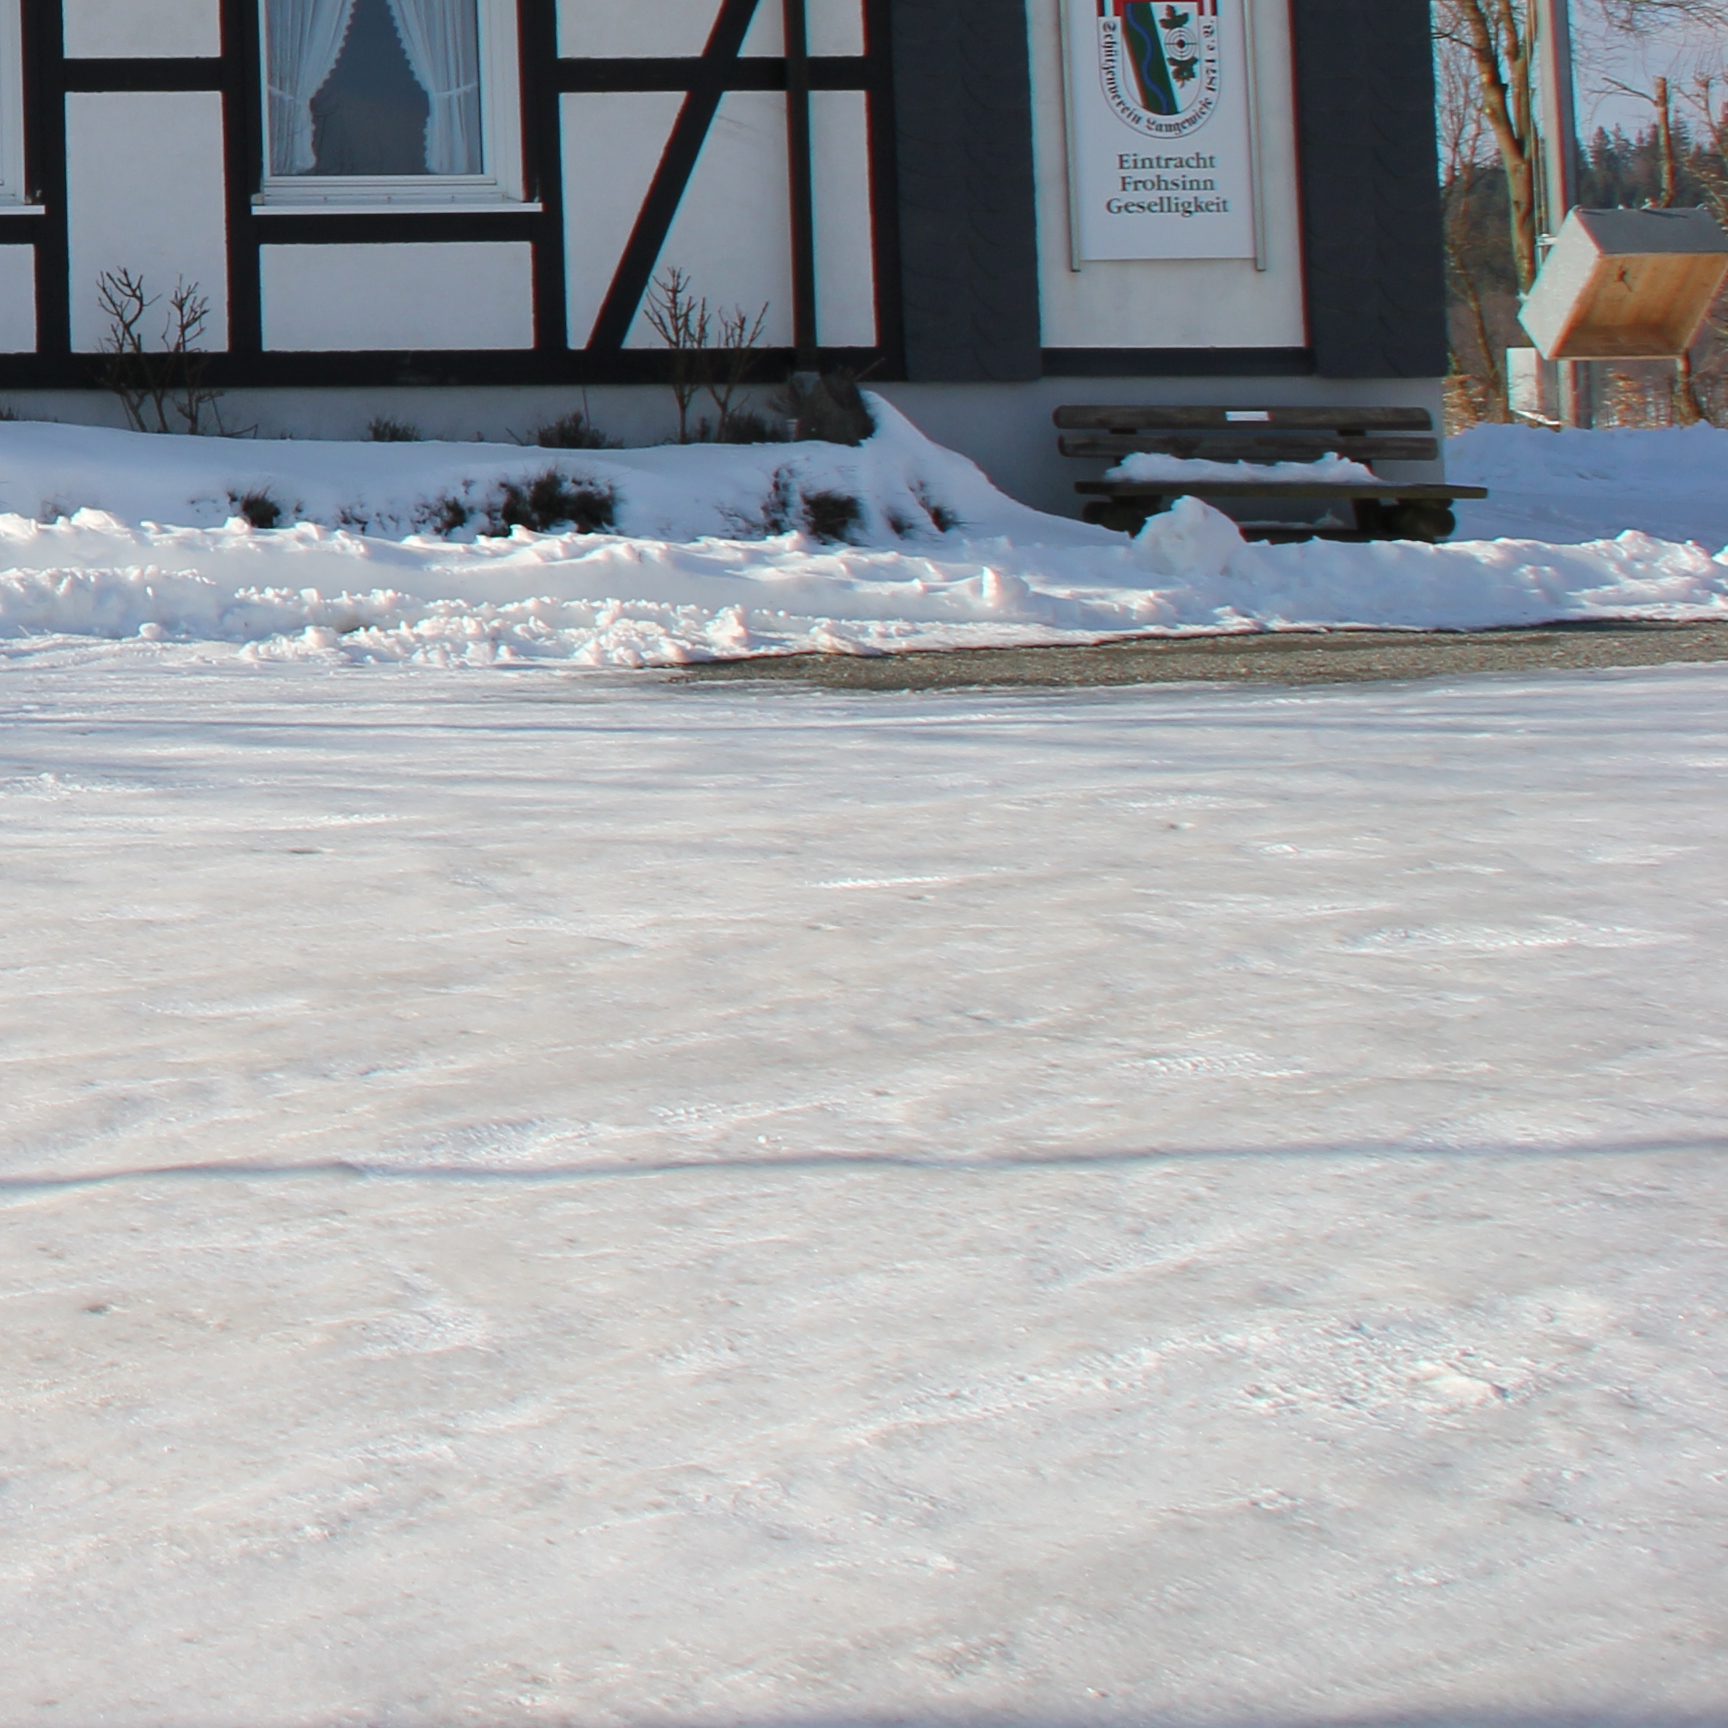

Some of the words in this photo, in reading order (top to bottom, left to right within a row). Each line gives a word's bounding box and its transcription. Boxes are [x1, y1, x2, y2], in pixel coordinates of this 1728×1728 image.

[1117, 151, 1216, 170] Eintracht
[1120, 174, 1215, 192] Frohsinn
[1105, 195, 1230, 218] Geselligkeit
